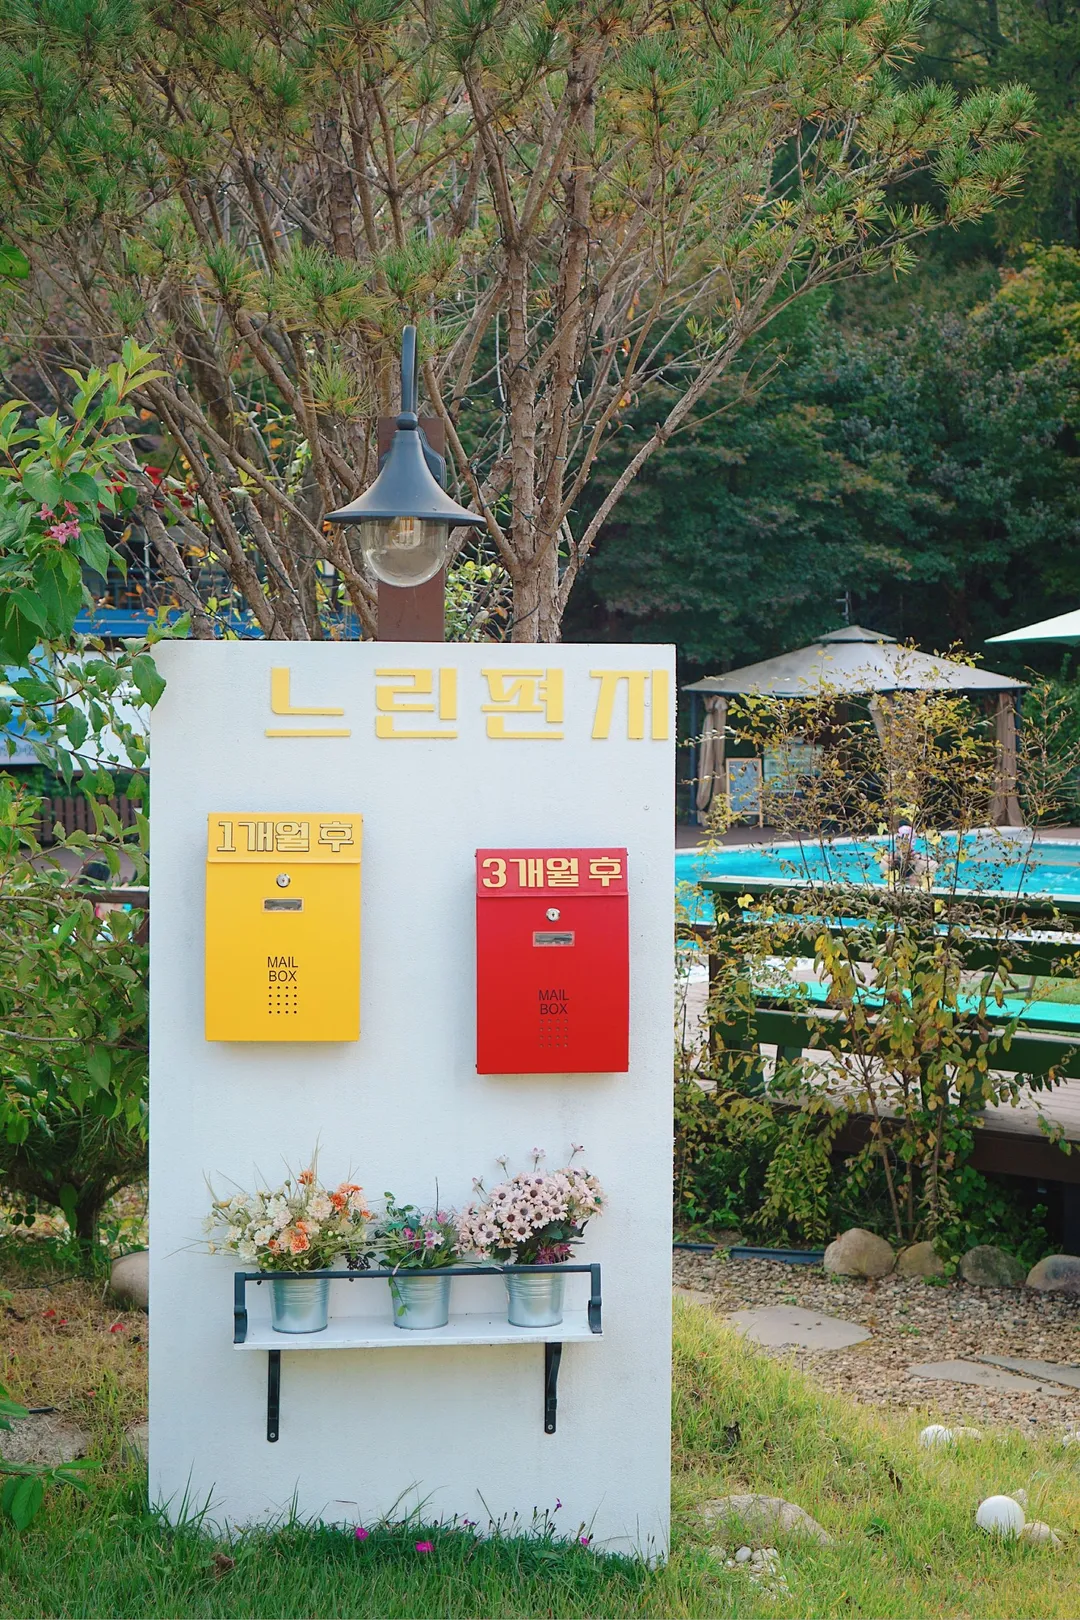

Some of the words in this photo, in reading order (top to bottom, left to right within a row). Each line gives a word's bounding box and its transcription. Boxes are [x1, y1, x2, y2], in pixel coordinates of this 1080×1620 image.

[216, 821, 309, 852] 1개월
[318, 821, 354, 852] 후
[482, 857, 580, 888] 3개월
[588, 856, 623, 887] 후
[267, 956, 298, 968] MAIL
[268, 970, 297, 982] BOX
[538, 989, 569, 1001] MAIL
[539, 1003, 568, 1015] BOX
